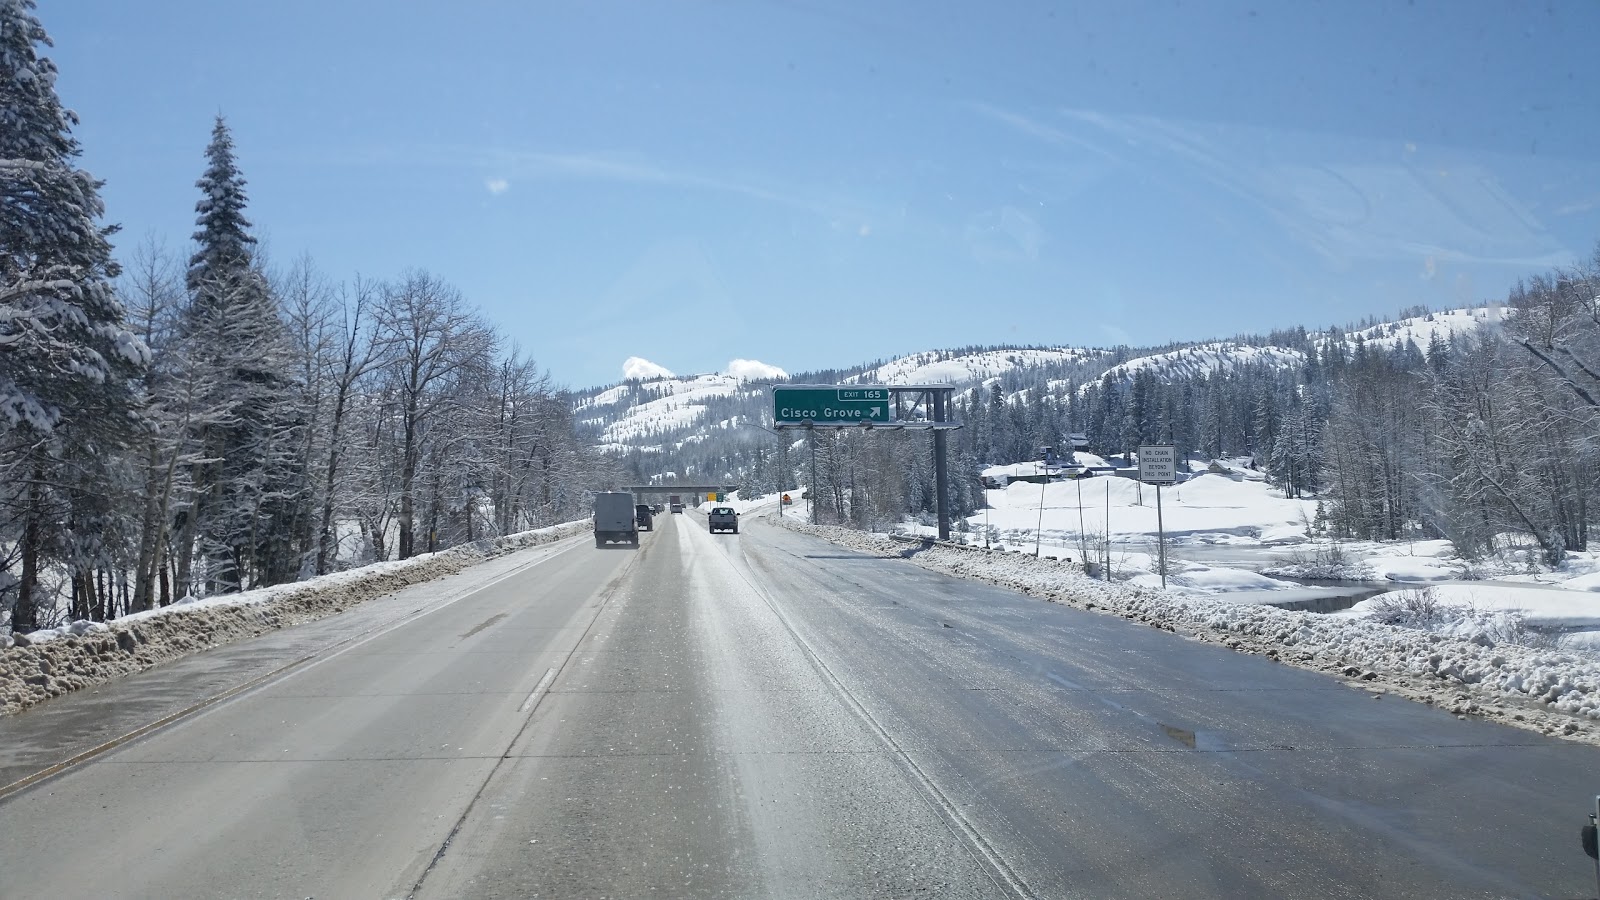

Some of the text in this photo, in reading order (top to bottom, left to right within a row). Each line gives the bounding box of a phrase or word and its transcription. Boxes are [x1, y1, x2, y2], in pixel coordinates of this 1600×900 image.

[864, 390, 881, 399] 165
[781, 407, 861, 418] Cisco Grove
